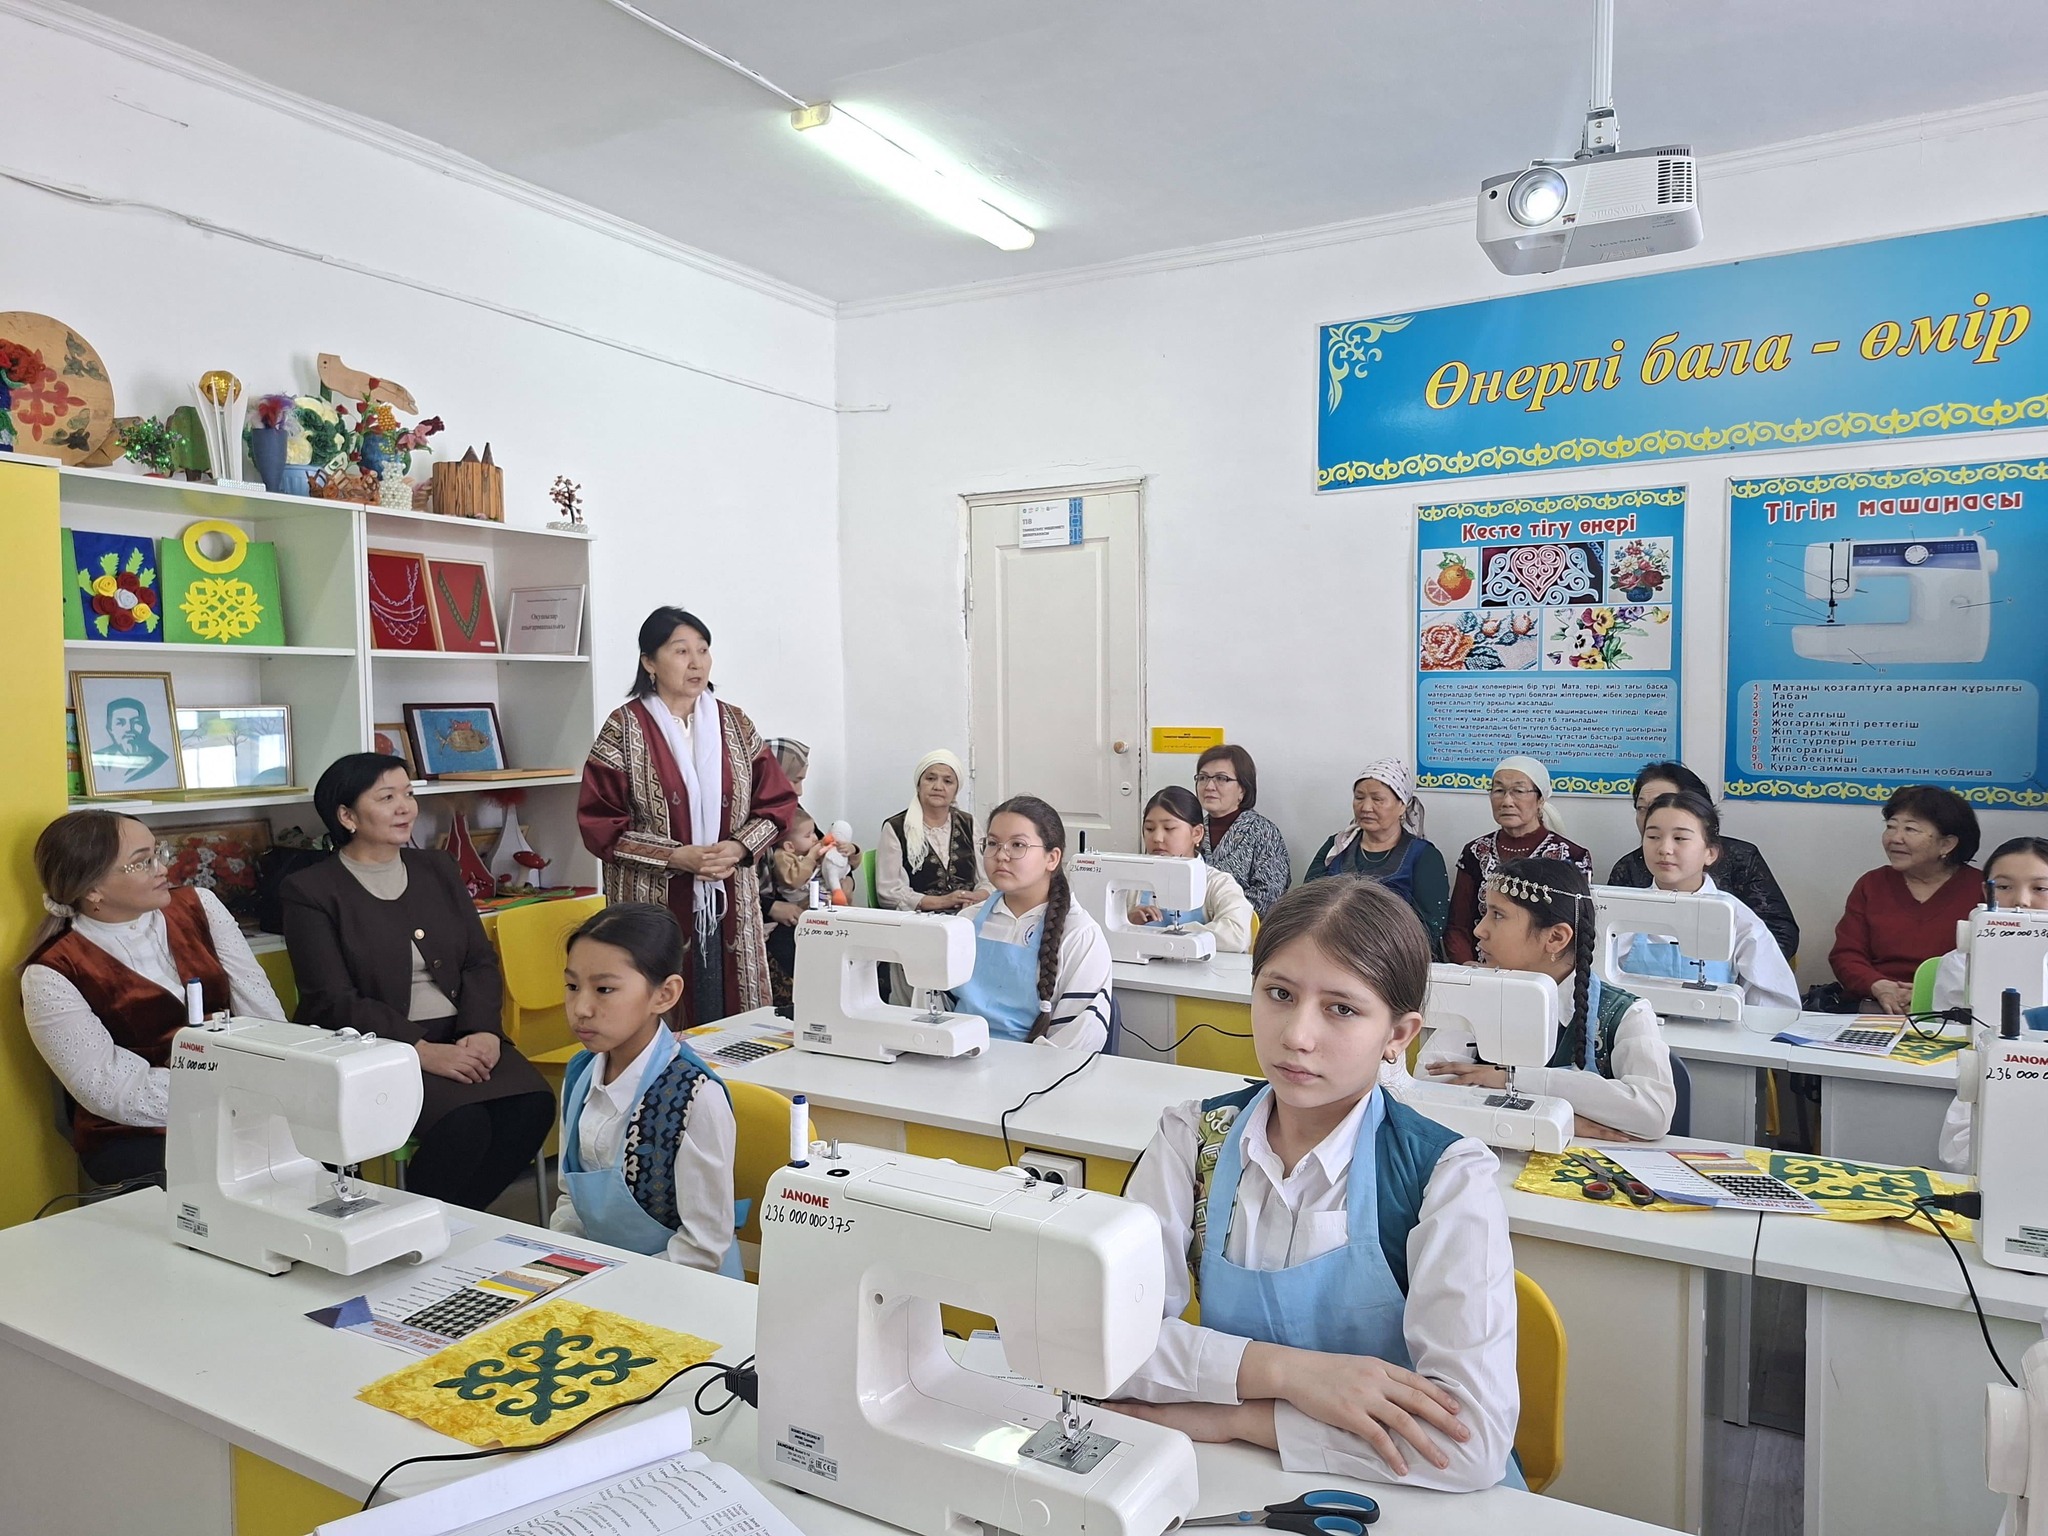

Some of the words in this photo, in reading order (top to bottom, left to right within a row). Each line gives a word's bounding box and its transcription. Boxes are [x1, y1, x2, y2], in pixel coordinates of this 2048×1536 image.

[1424, 339, 1625, 412] Өнерлі
[1640, 331, 1793, 386] бала
[1811, 340, 1840, 355] -
[1859, 292, 2033, 365] өмір
[1765, 500, 1836, 524] Тігін
[1859, 492, 2022, 516] машинасы
[1462, 524, 1521, 542] Кесте
[1529, 520, 1571, 539] тігу
[1580, 514, 1636, 536] өнері
[1527, 683, 1538, 691] бір
[1773, 683, 1820, 691] Матаны
[1824, 684, 1892, 693] қозғалтуға
[1896, 685, 1957, 693] арналған
[1961, 685, 2022, 693] құрылғы
[1798, 711, 1846, 719] салғыш
[1864, 720, 1919, 729] реттегіш
[1771, 728, 1792, 736] Жіп
[1797, 729, 1850, 737] тартқыш
[1802, 738, 1857, 747] түрлерін
[1861, 739, 1917, 747] реттегіш
[1771, 754, 1798, 762] Тігіс
[1802, 755, 1858, 763] бекіткіші
[1934, 767, 1993, 777] қобдиша
[805, 918, 829, 926] JANOME
[1986, 920, 2022, 928] JANOME
[1977, 928, 1996, 938] 236
[179, 1041, 205, 1054] JANOME
[1986, 1067, 2011, 1080] 236
[2016, 1070, 2039, 1079] 000
[780, 1188, 830, 1209] JANOME
[765, 1204, 785, 1223] 236
[789, 1208, 808, 1224] 000
